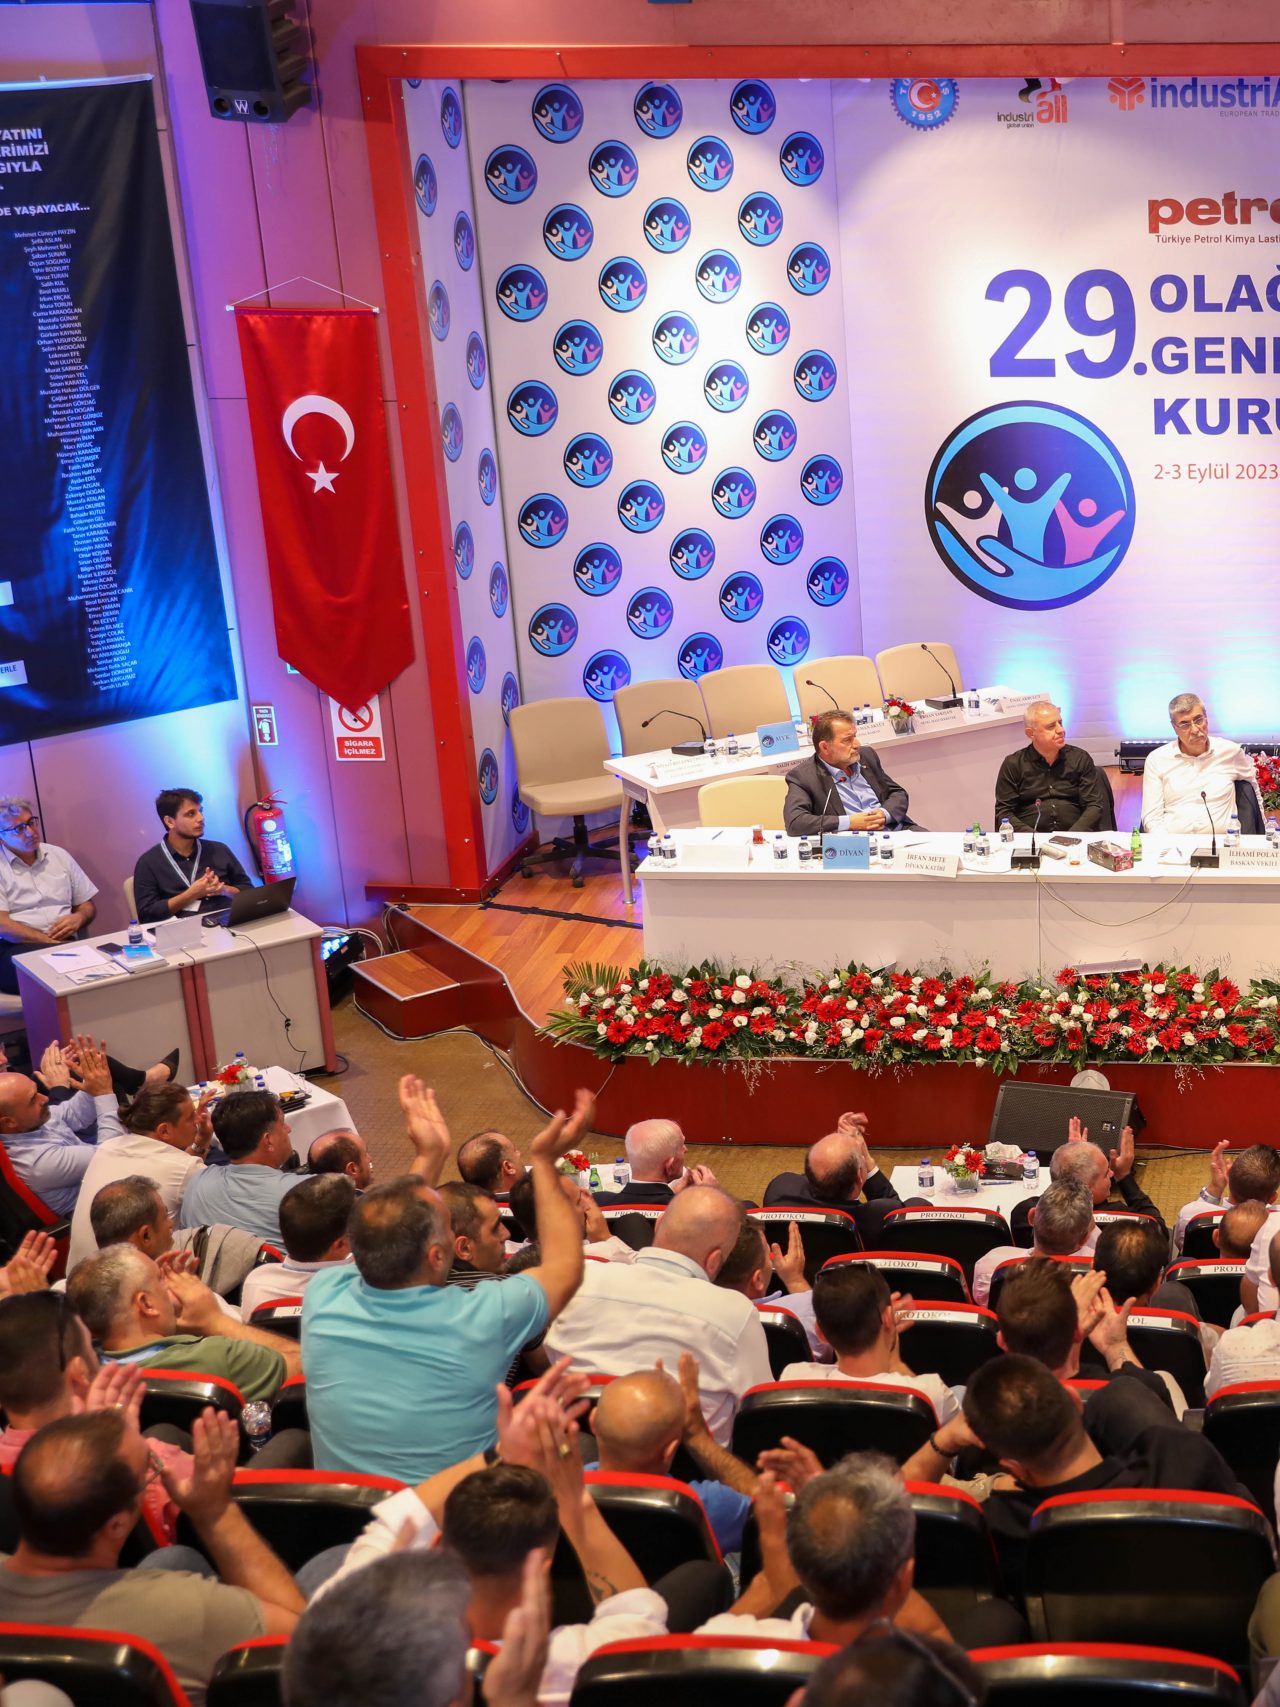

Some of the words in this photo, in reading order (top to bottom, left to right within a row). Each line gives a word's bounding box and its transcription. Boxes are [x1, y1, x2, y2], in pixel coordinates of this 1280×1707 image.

[997, 112, 1034, 122] industri
[0, 142, 49, 157] RİMİZİ
[14, 202, 90, 216] YAŞAYACAK...
[1155, 234, 1192, 246] Türkiye
[1194, 234, 1222, 244] Petrol
[1225, 234, 1255, 246] Kimya
[984, 268, 1148, 379] 29.
[1154, 463, 1181, 480] 2-3
[1188, 462, 1230, 484] Eylül
[1235, 463, 1278, 480] 2023
[344, 748, 376, 756] İÇİLMEZ
[839, 848, 864, 856] DİVAN
[1229, 849, 1255, 858] İLHAMİ
[907, 853, 927, 862] İRFAN
[905, 862, 923, 870] DİVAN
